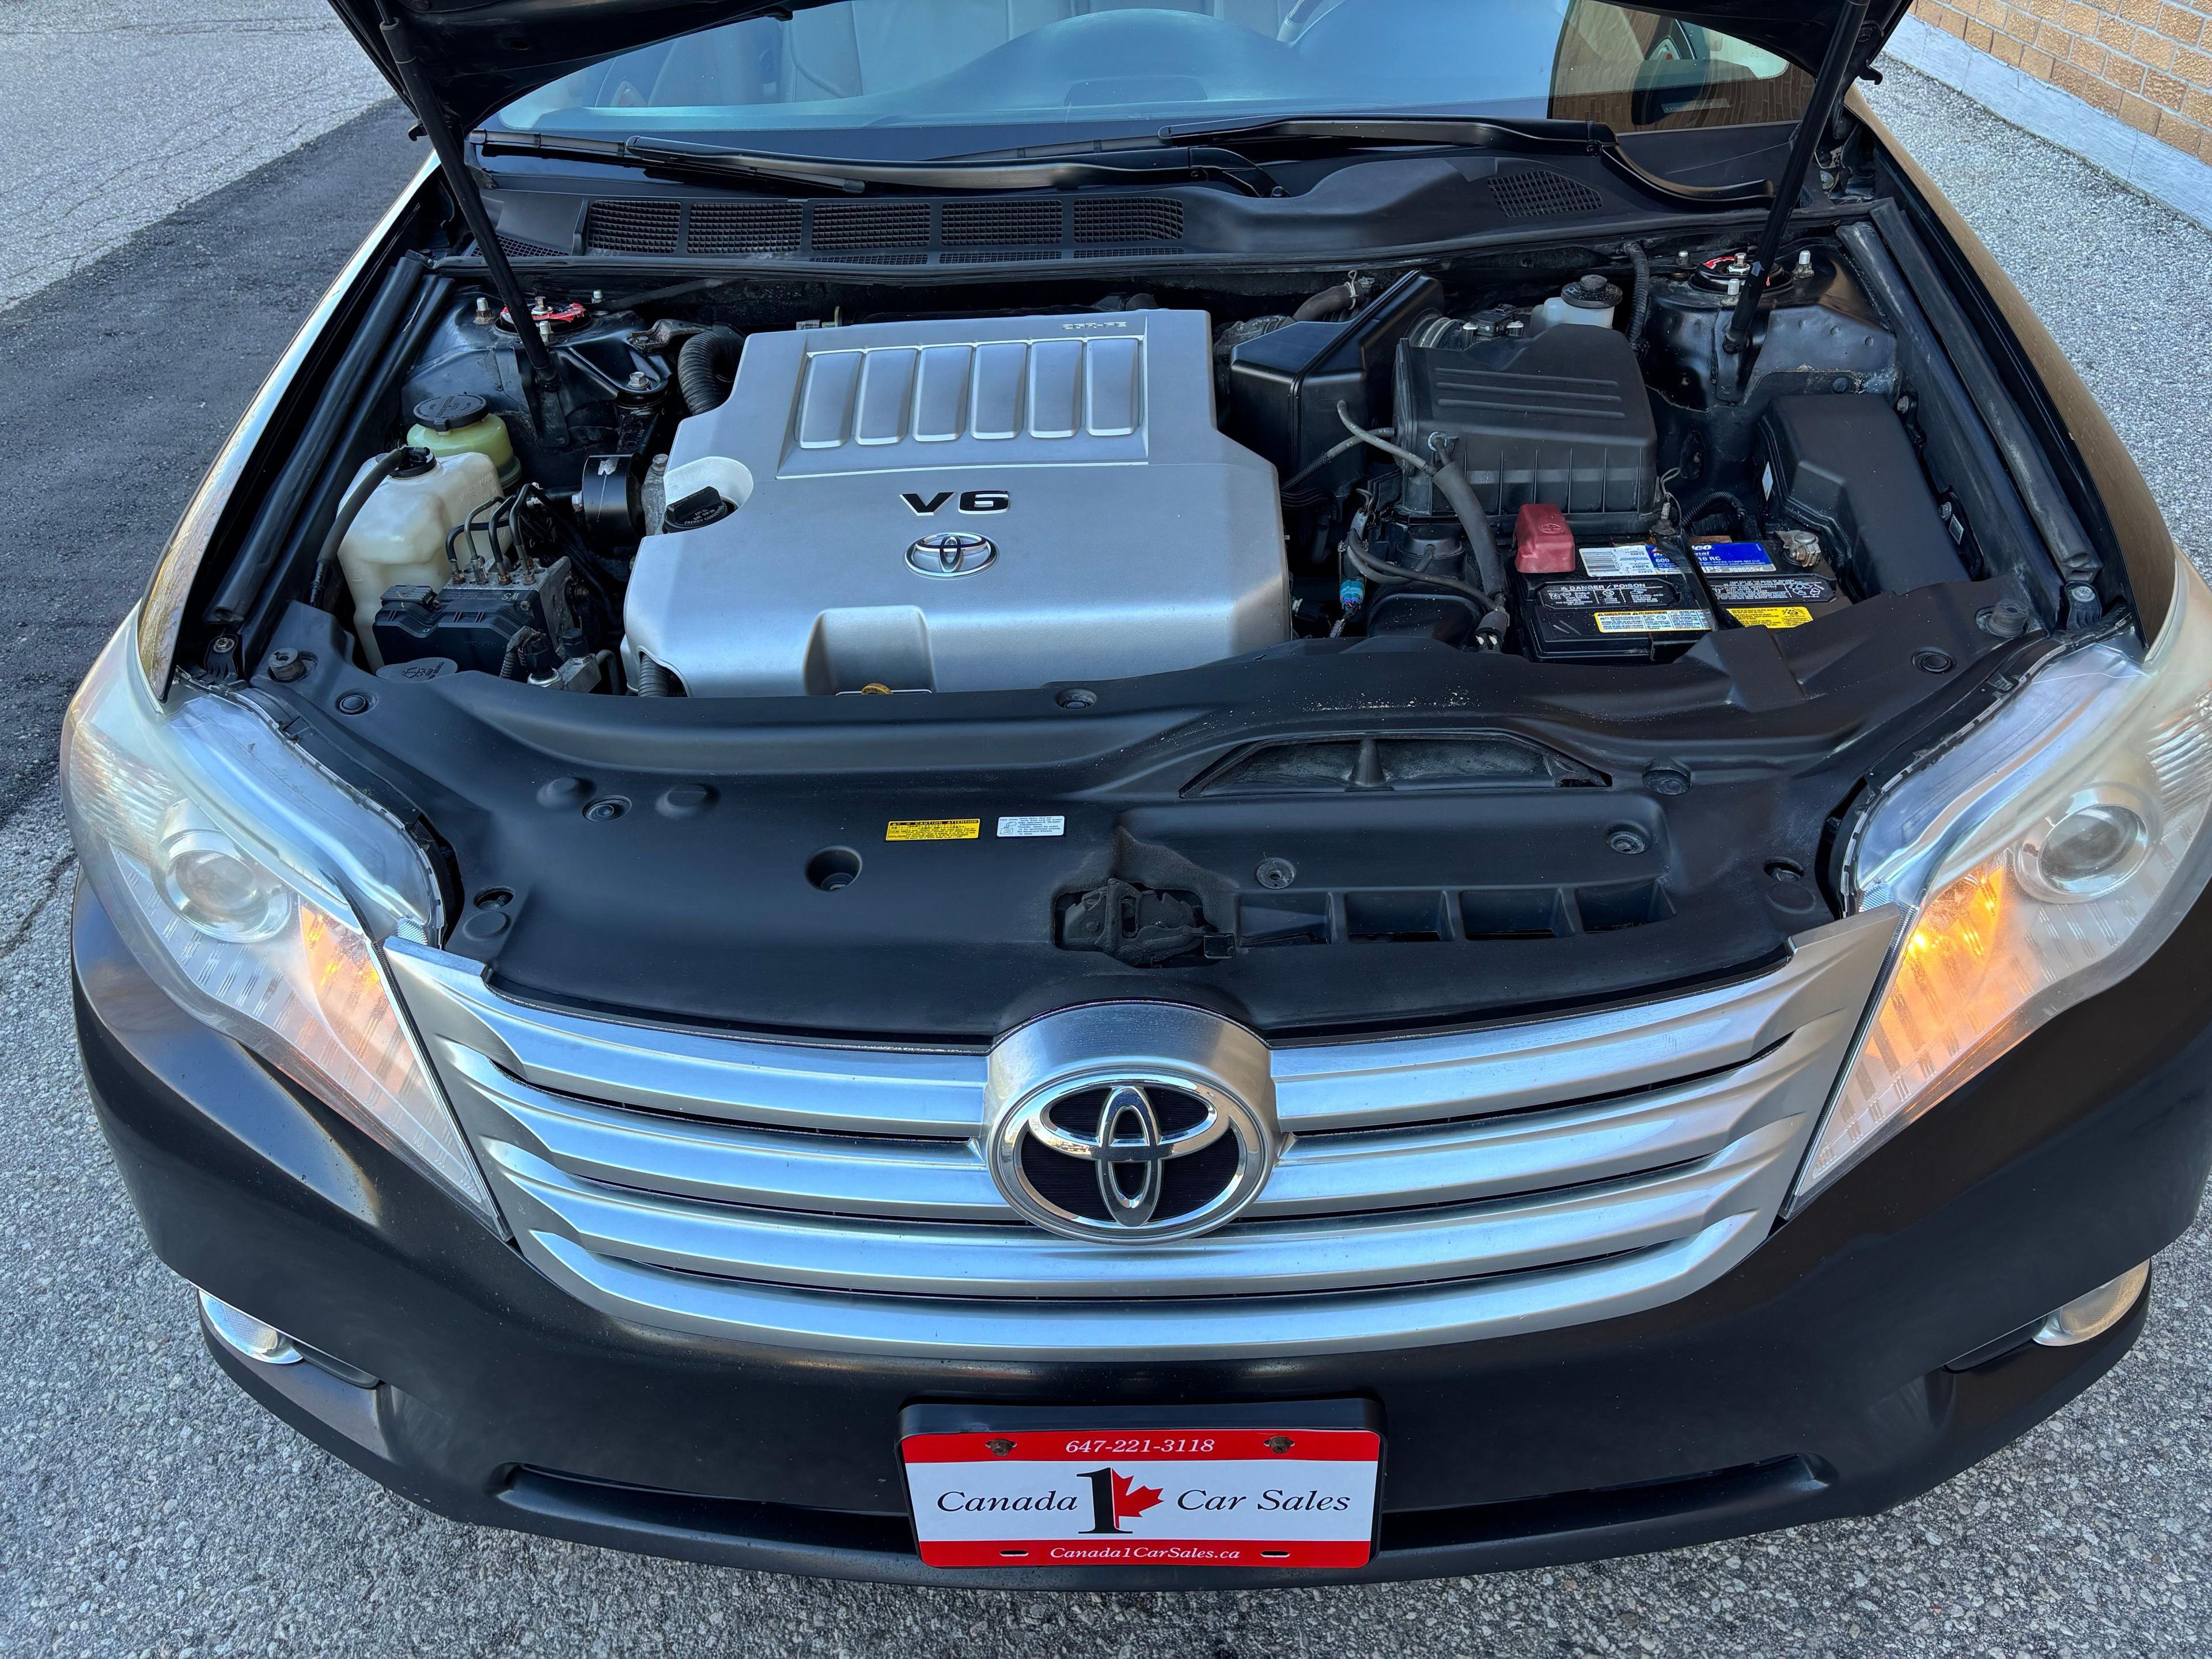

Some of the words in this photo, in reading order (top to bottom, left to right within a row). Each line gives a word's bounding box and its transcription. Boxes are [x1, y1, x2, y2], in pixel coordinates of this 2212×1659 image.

[899, 490, 1010, 516] V6
[1066, 1440, 1214, 1453] 647-221-3118
[937, 1490, 1078, 1512] Canada
[1077, 1467, 1133, 1534] 1
[1177, 1490, 1248, 1512] Car
[1256, 1490, 1351, 1512] Sales
[1050, 1547, 1241, 1560] Canada1CarSales.ca
